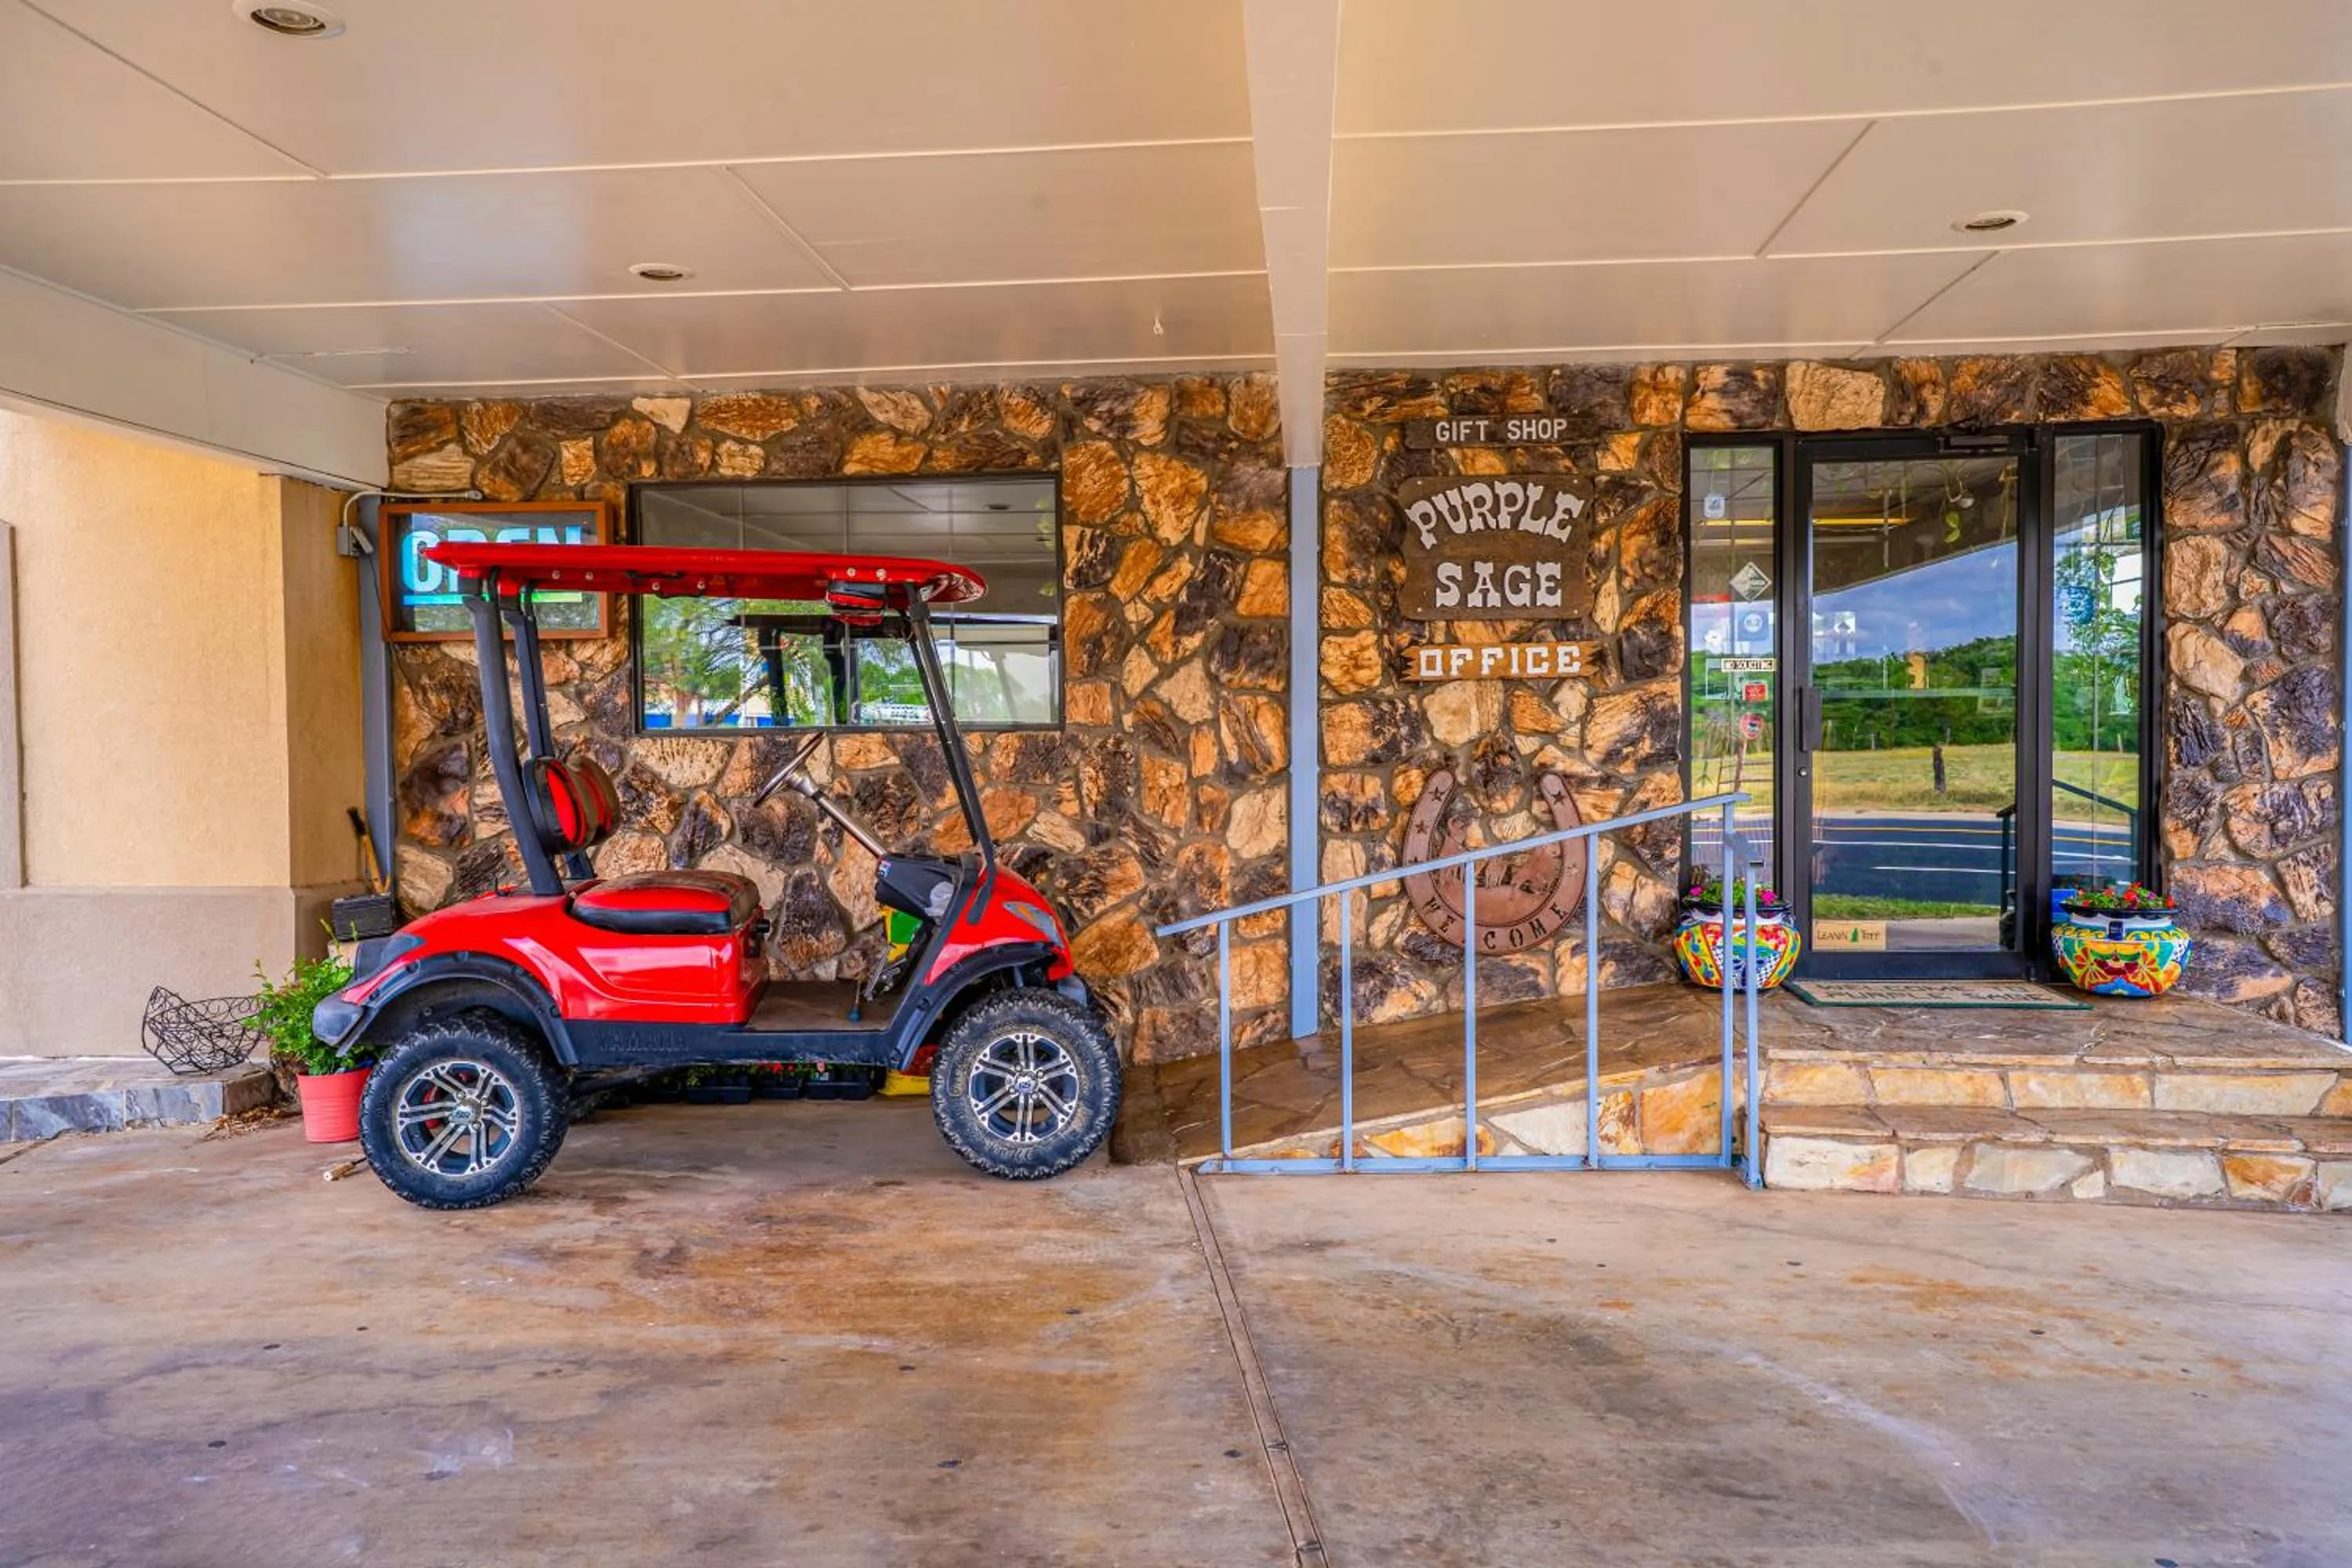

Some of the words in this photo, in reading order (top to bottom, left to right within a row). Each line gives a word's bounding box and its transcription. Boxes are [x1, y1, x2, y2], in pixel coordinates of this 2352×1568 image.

[1436, 420, 1489, 441] GIFT
[1507, 418, 1567, 440] SHOP
[1404, 481, 1585, 550] PURPLE
[1436, 561, 1562, 608] SAGE
[1420, 645, 1581, 677] OFFICE
[1421, 895, 1568, 950] WECOME
